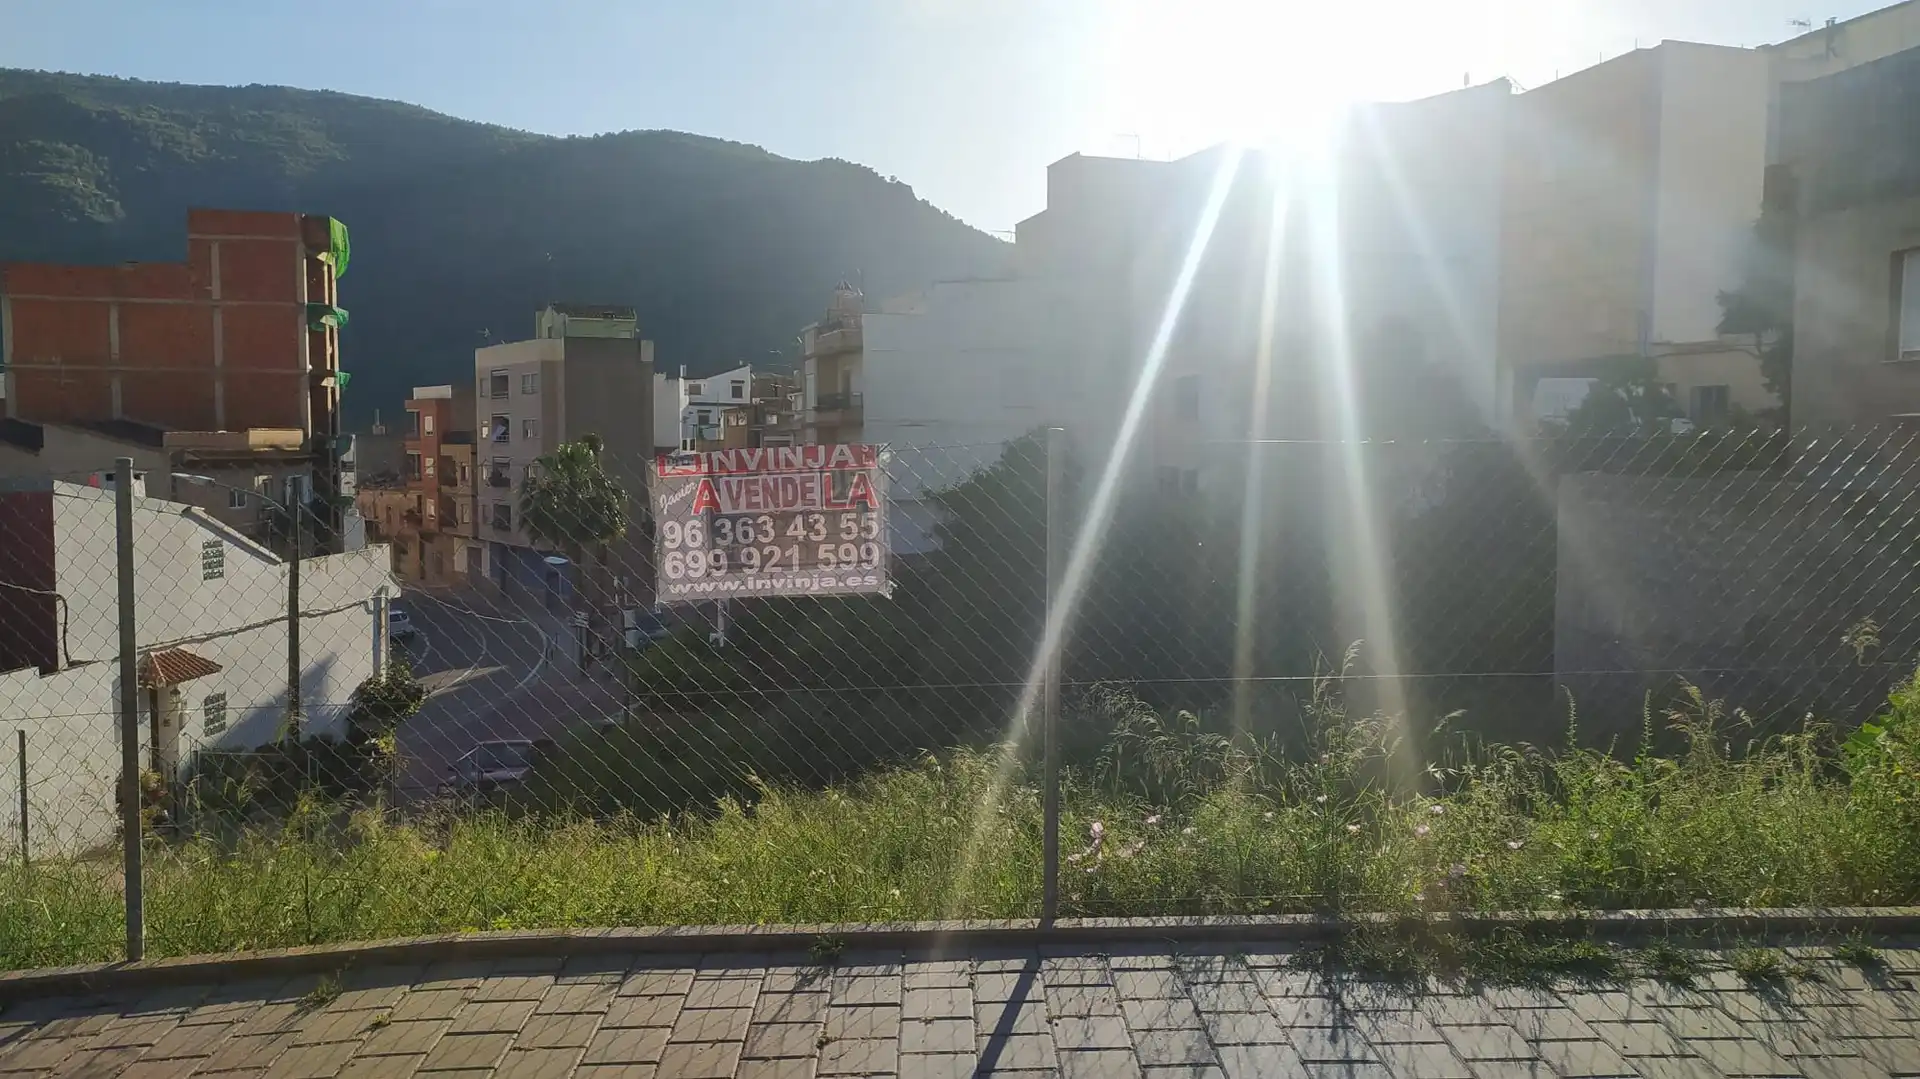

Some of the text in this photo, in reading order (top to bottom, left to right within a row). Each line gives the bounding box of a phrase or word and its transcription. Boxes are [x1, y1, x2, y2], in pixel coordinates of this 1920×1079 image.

[701, 445, 857, 473] INVINJA
[723, 475, 817, 512] VENDE
[823, 471, 880, 510] LA
[662, 512, 879, 549] 96 363 43 55
[664, 543, 880, 579] 699 921 599
[668, 575, 878, 594] www.invinja.es
